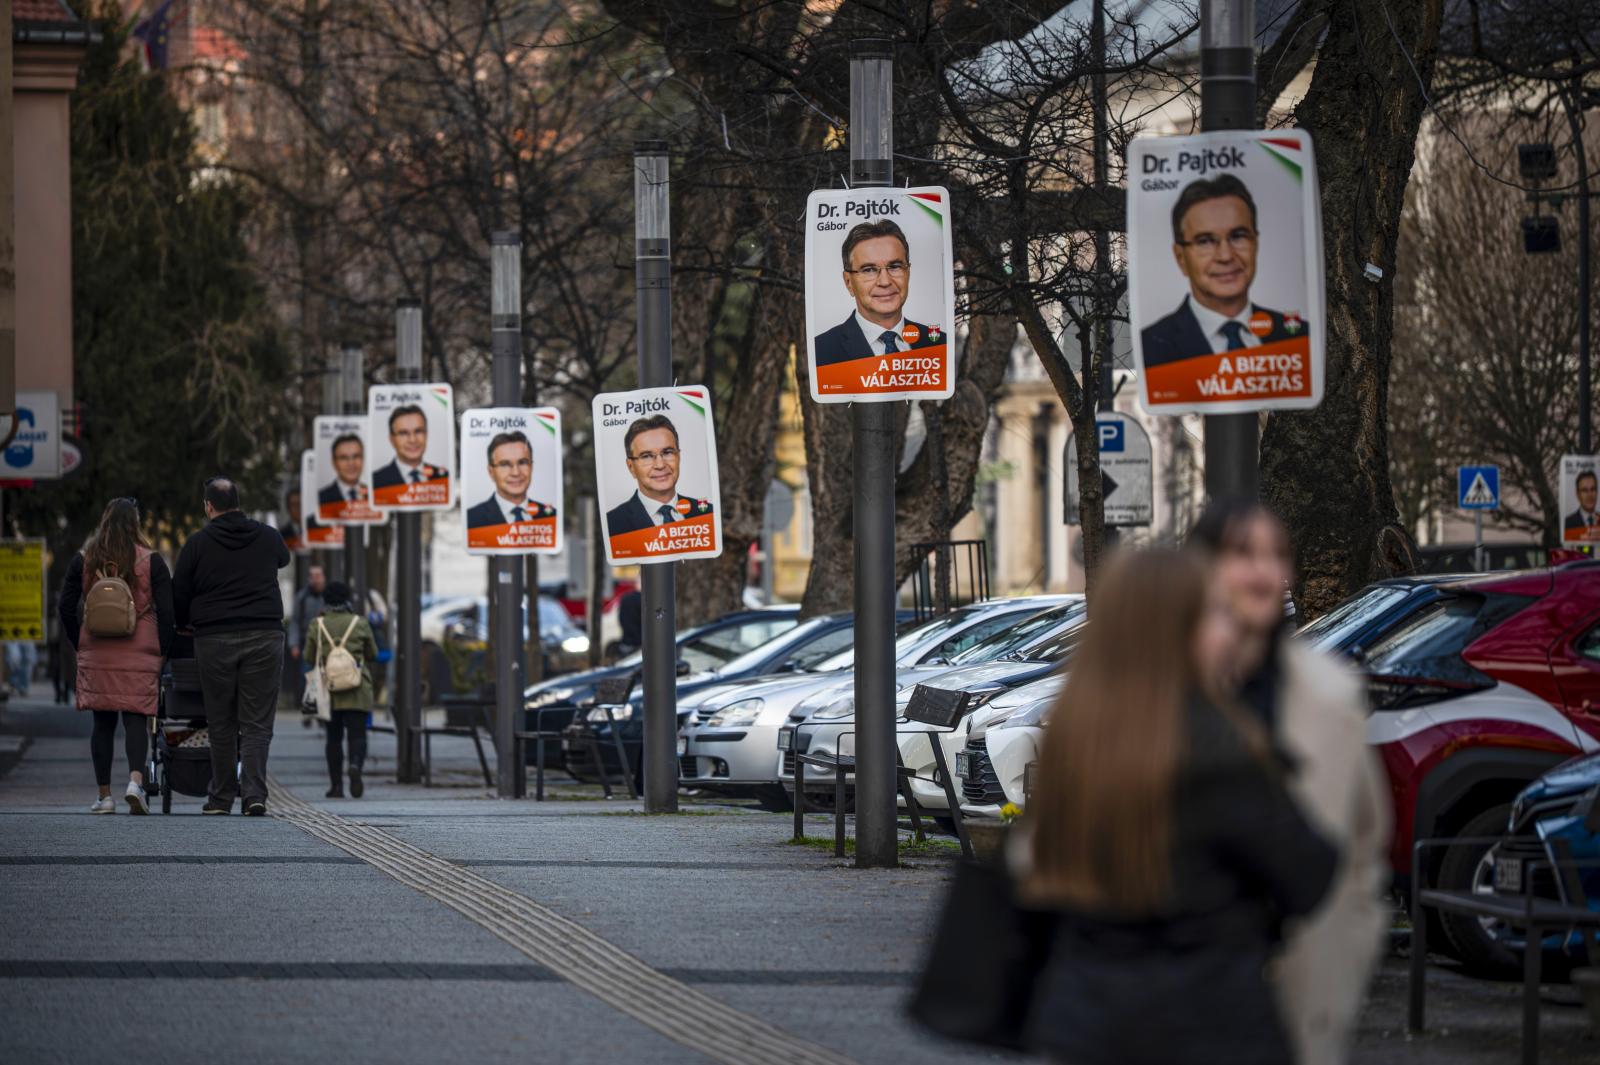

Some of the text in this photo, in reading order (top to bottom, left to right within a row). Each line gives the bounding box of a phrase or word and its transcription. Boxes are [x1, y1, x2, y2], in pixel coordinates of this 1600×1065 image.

[1142, 147, 1246, 175] Dr. Pajtók
[1141, 179, 1179, 192] Gábor
[817, 199, 901, 219] Dr. Pajtók
[817, 221, 847, 231] Gábor
[878, 357, 941, 371] A BIZTOS
[1218, 354, 1303, 374] A BIZTOS
[860, 371, 941, 388] VÁLASZTÁS
[1196, 373, 1304, 396] VÁLASZTÁS
[603, 398, 670, 416] Dr. Pajtók
[470, 416, 527, 429] Dr. Pajtók
[603, 419, 628, 427] Gábor
[1099, 425, 1118, 449] P
[509, 524, 553, 534] A BIZTOS
[658, 524, 710, 539] A BIZTOS
[644, 536, 711, 552] VÁLASZTÁS
